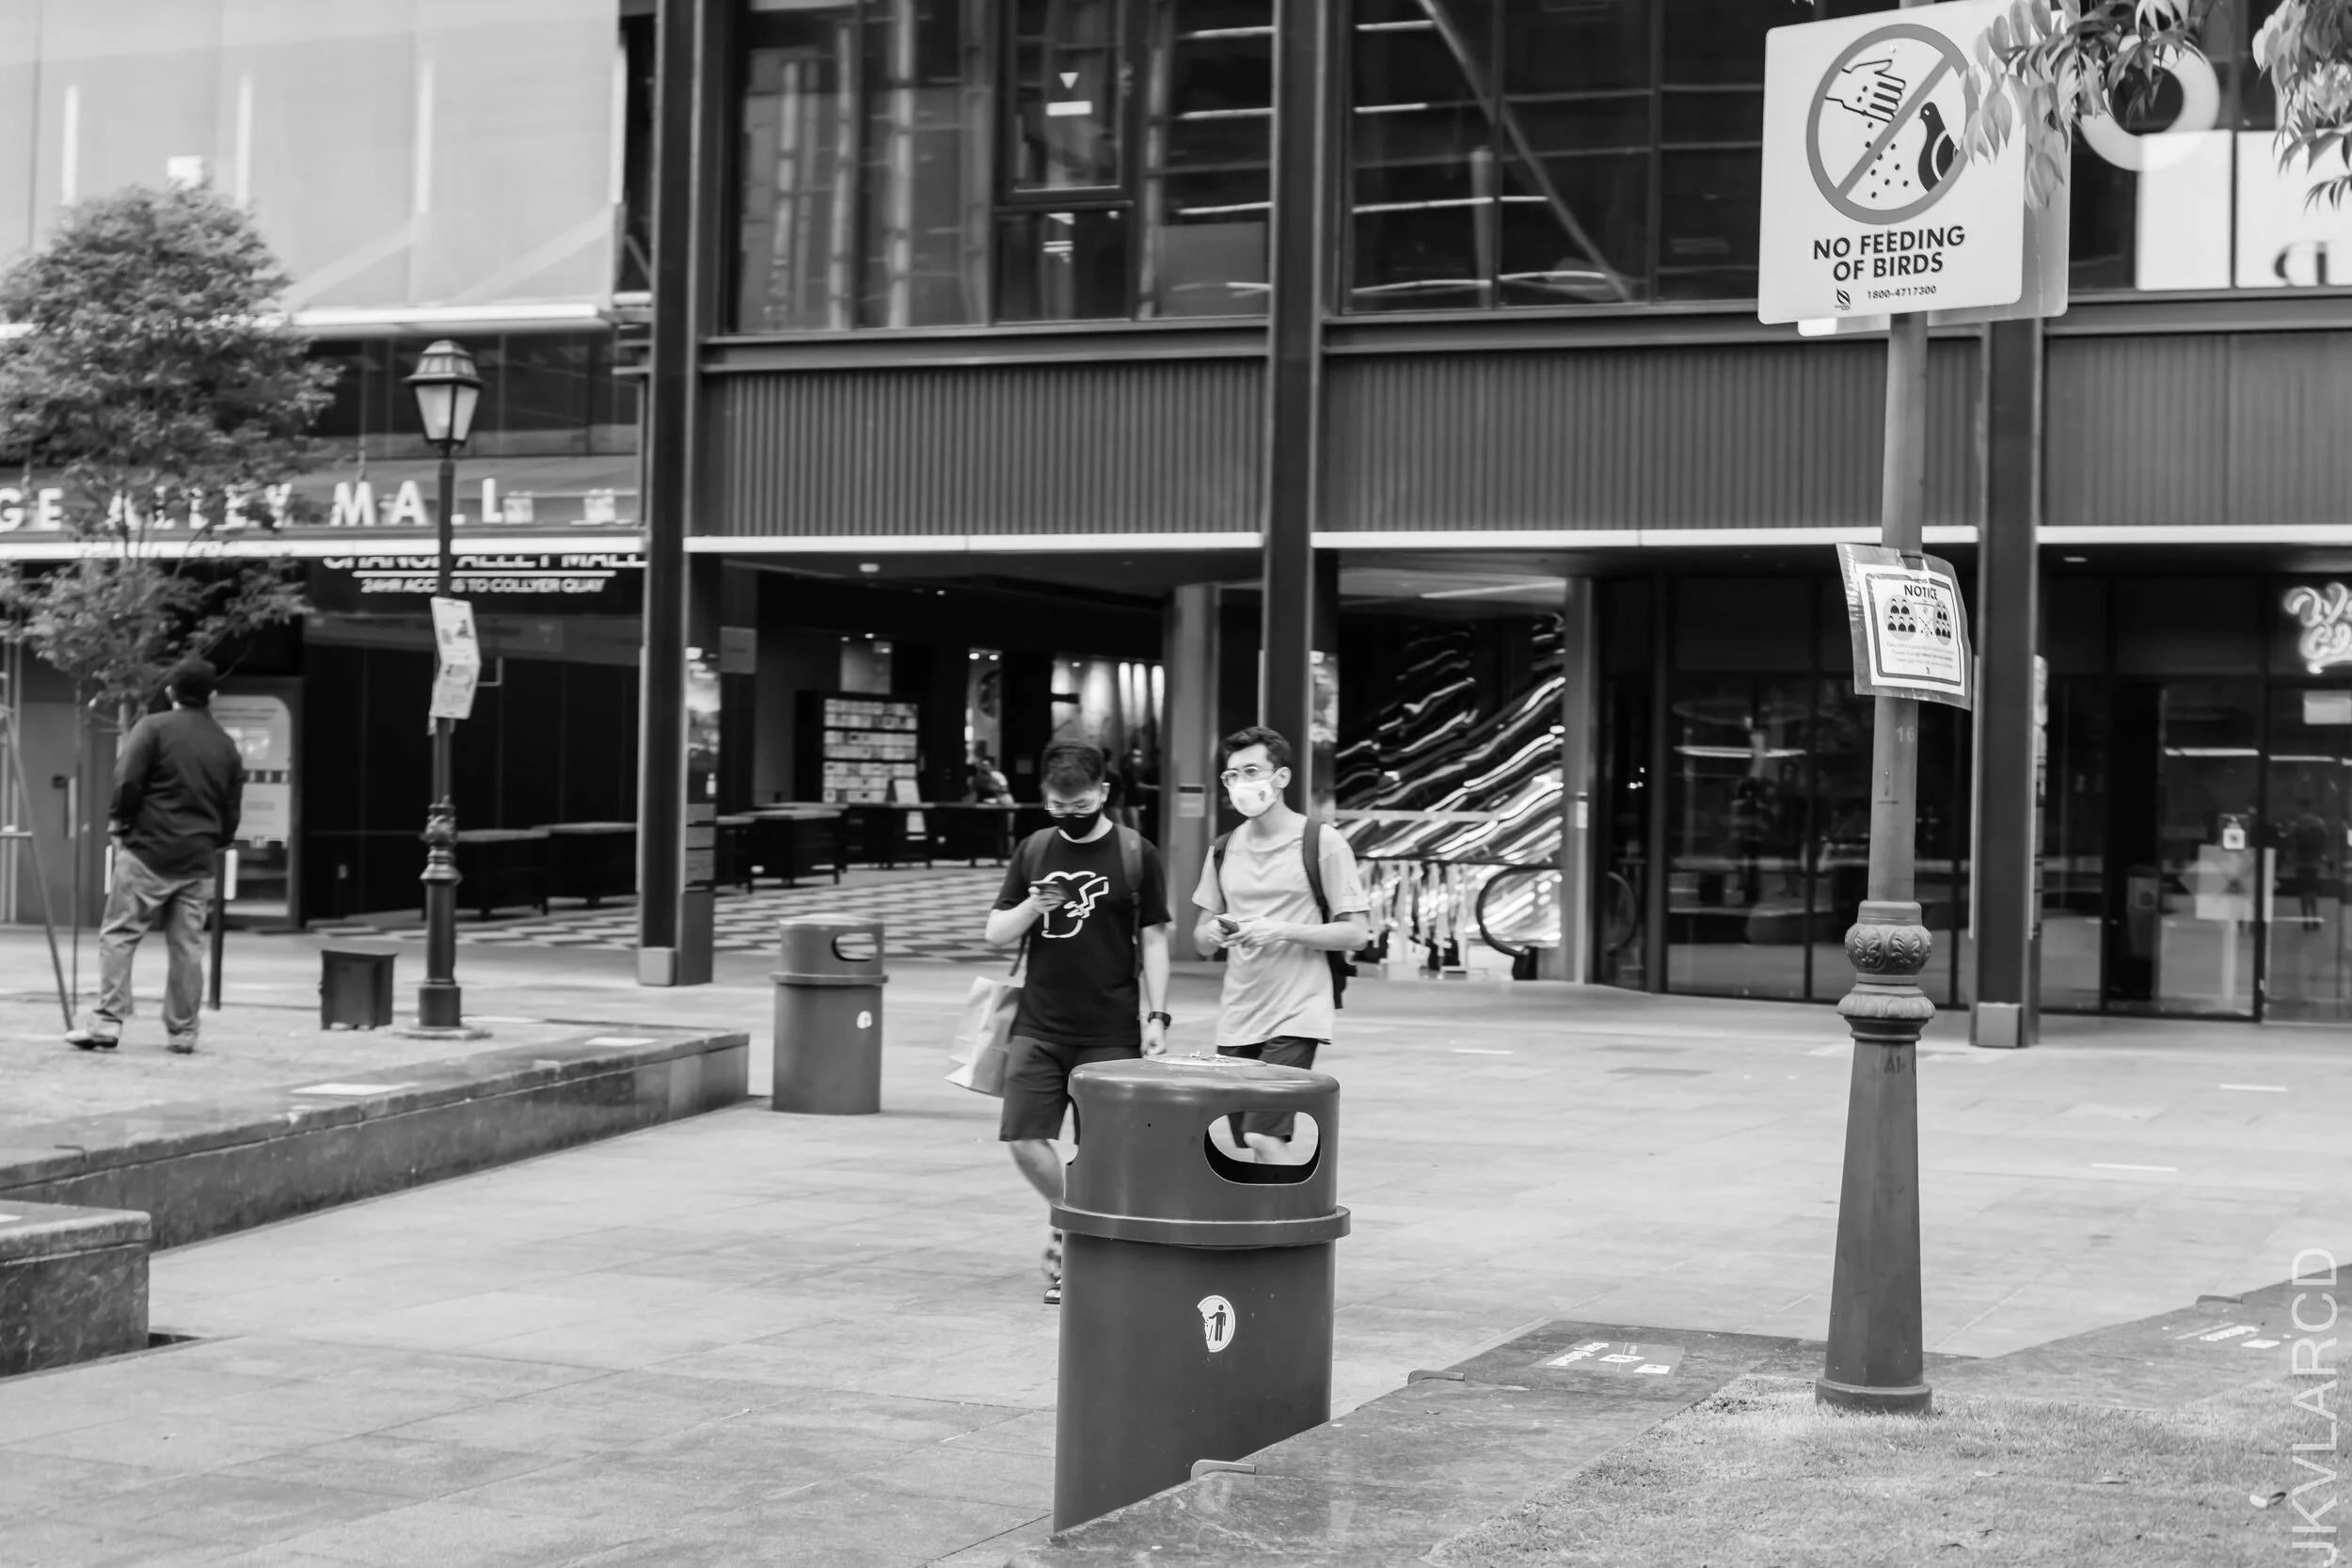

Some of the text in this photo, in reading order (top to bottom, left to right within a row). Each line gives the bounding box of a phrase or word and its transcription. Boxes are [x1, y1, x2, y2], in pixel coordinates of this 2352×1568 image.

[1813, 225, 1965, 260] NO FEEDING
[1834, 251, 1944, 281] OF BIRDS
[1867, 285, 1937, 299] 1800-4717300
[329, 478, 503, 527] MAL
[1903, 584, 1938, 600] NOTICE
[1895, 726, 1915, 743] 16
